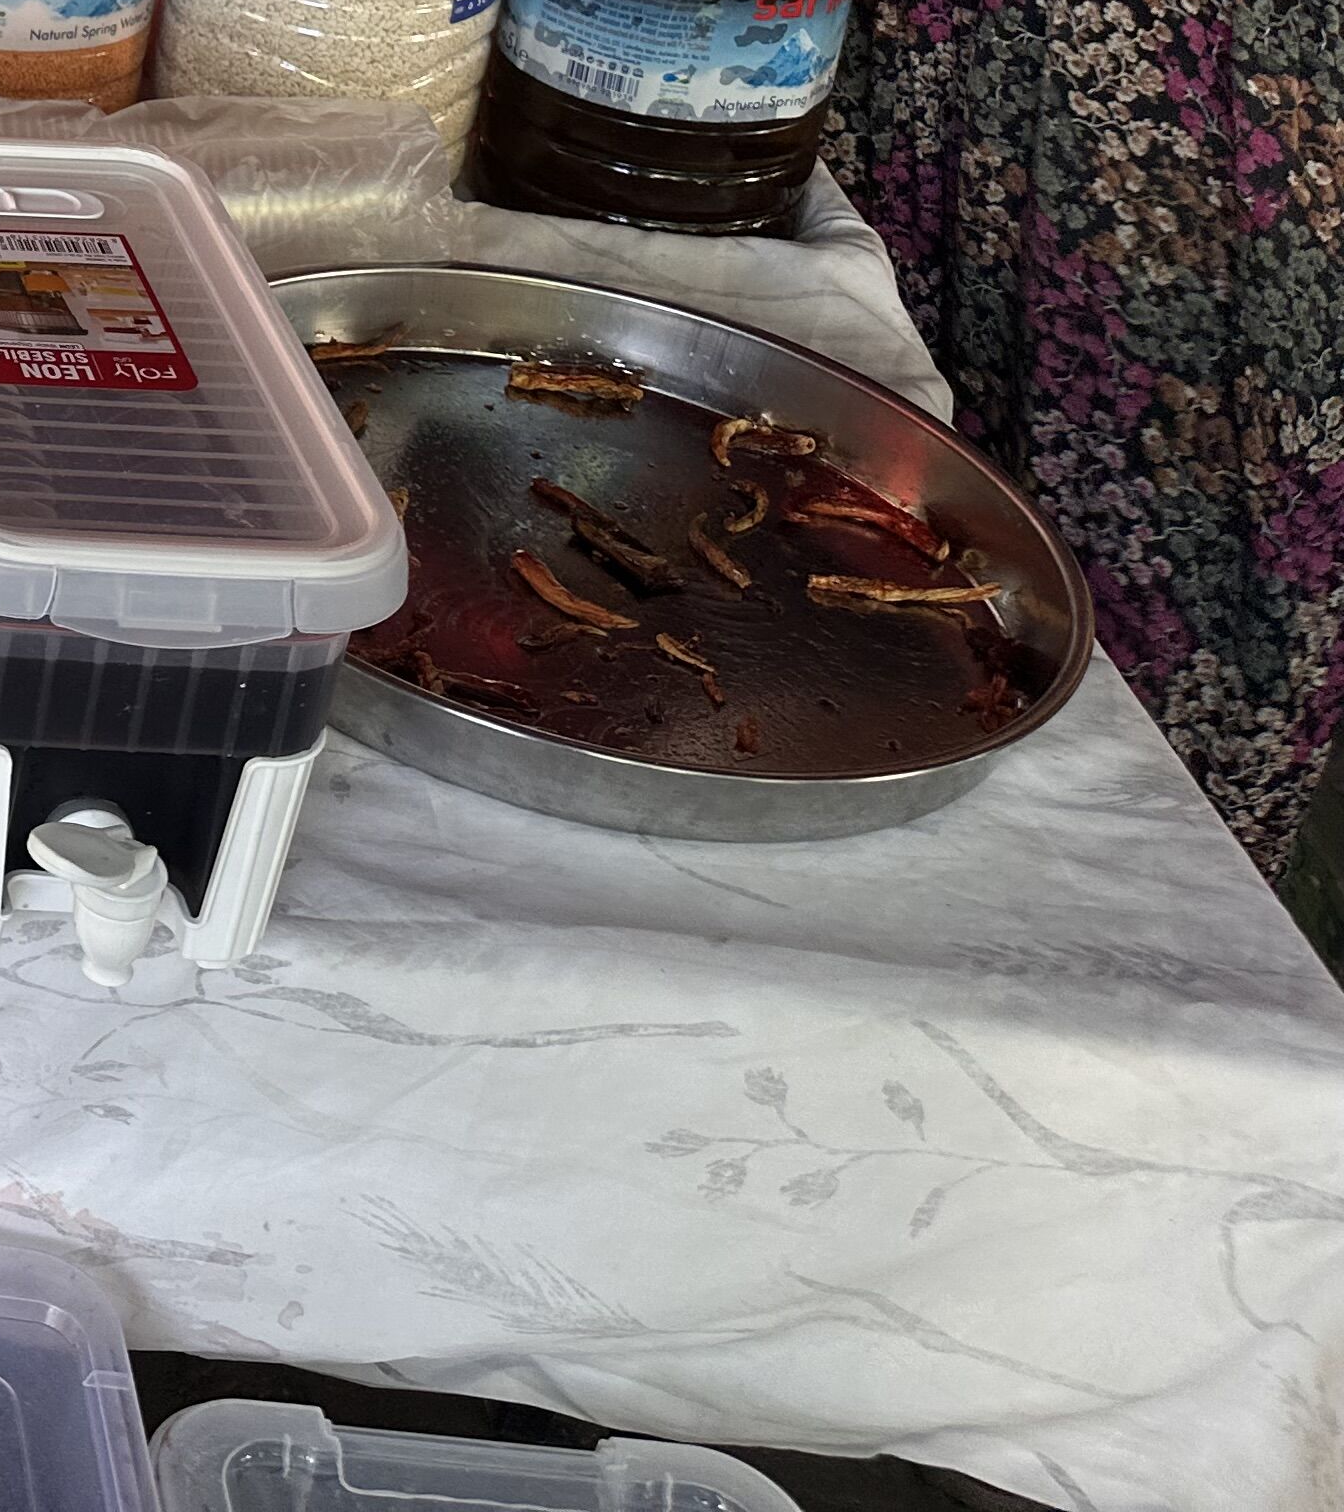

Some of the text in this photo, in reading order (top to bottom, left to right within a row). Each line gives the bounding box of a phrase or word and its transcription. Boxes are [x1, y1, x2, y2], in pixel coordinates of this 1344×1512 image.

[29, 25, 79, 41] Natural
[81, 23, 117, 41] Spring
[713, 95, 808, 112] Natural Spring
[61, 351, 89, 363] SU
[21, 362, 96, 381] LEON
[113, 363, 178, 383] FOLY
